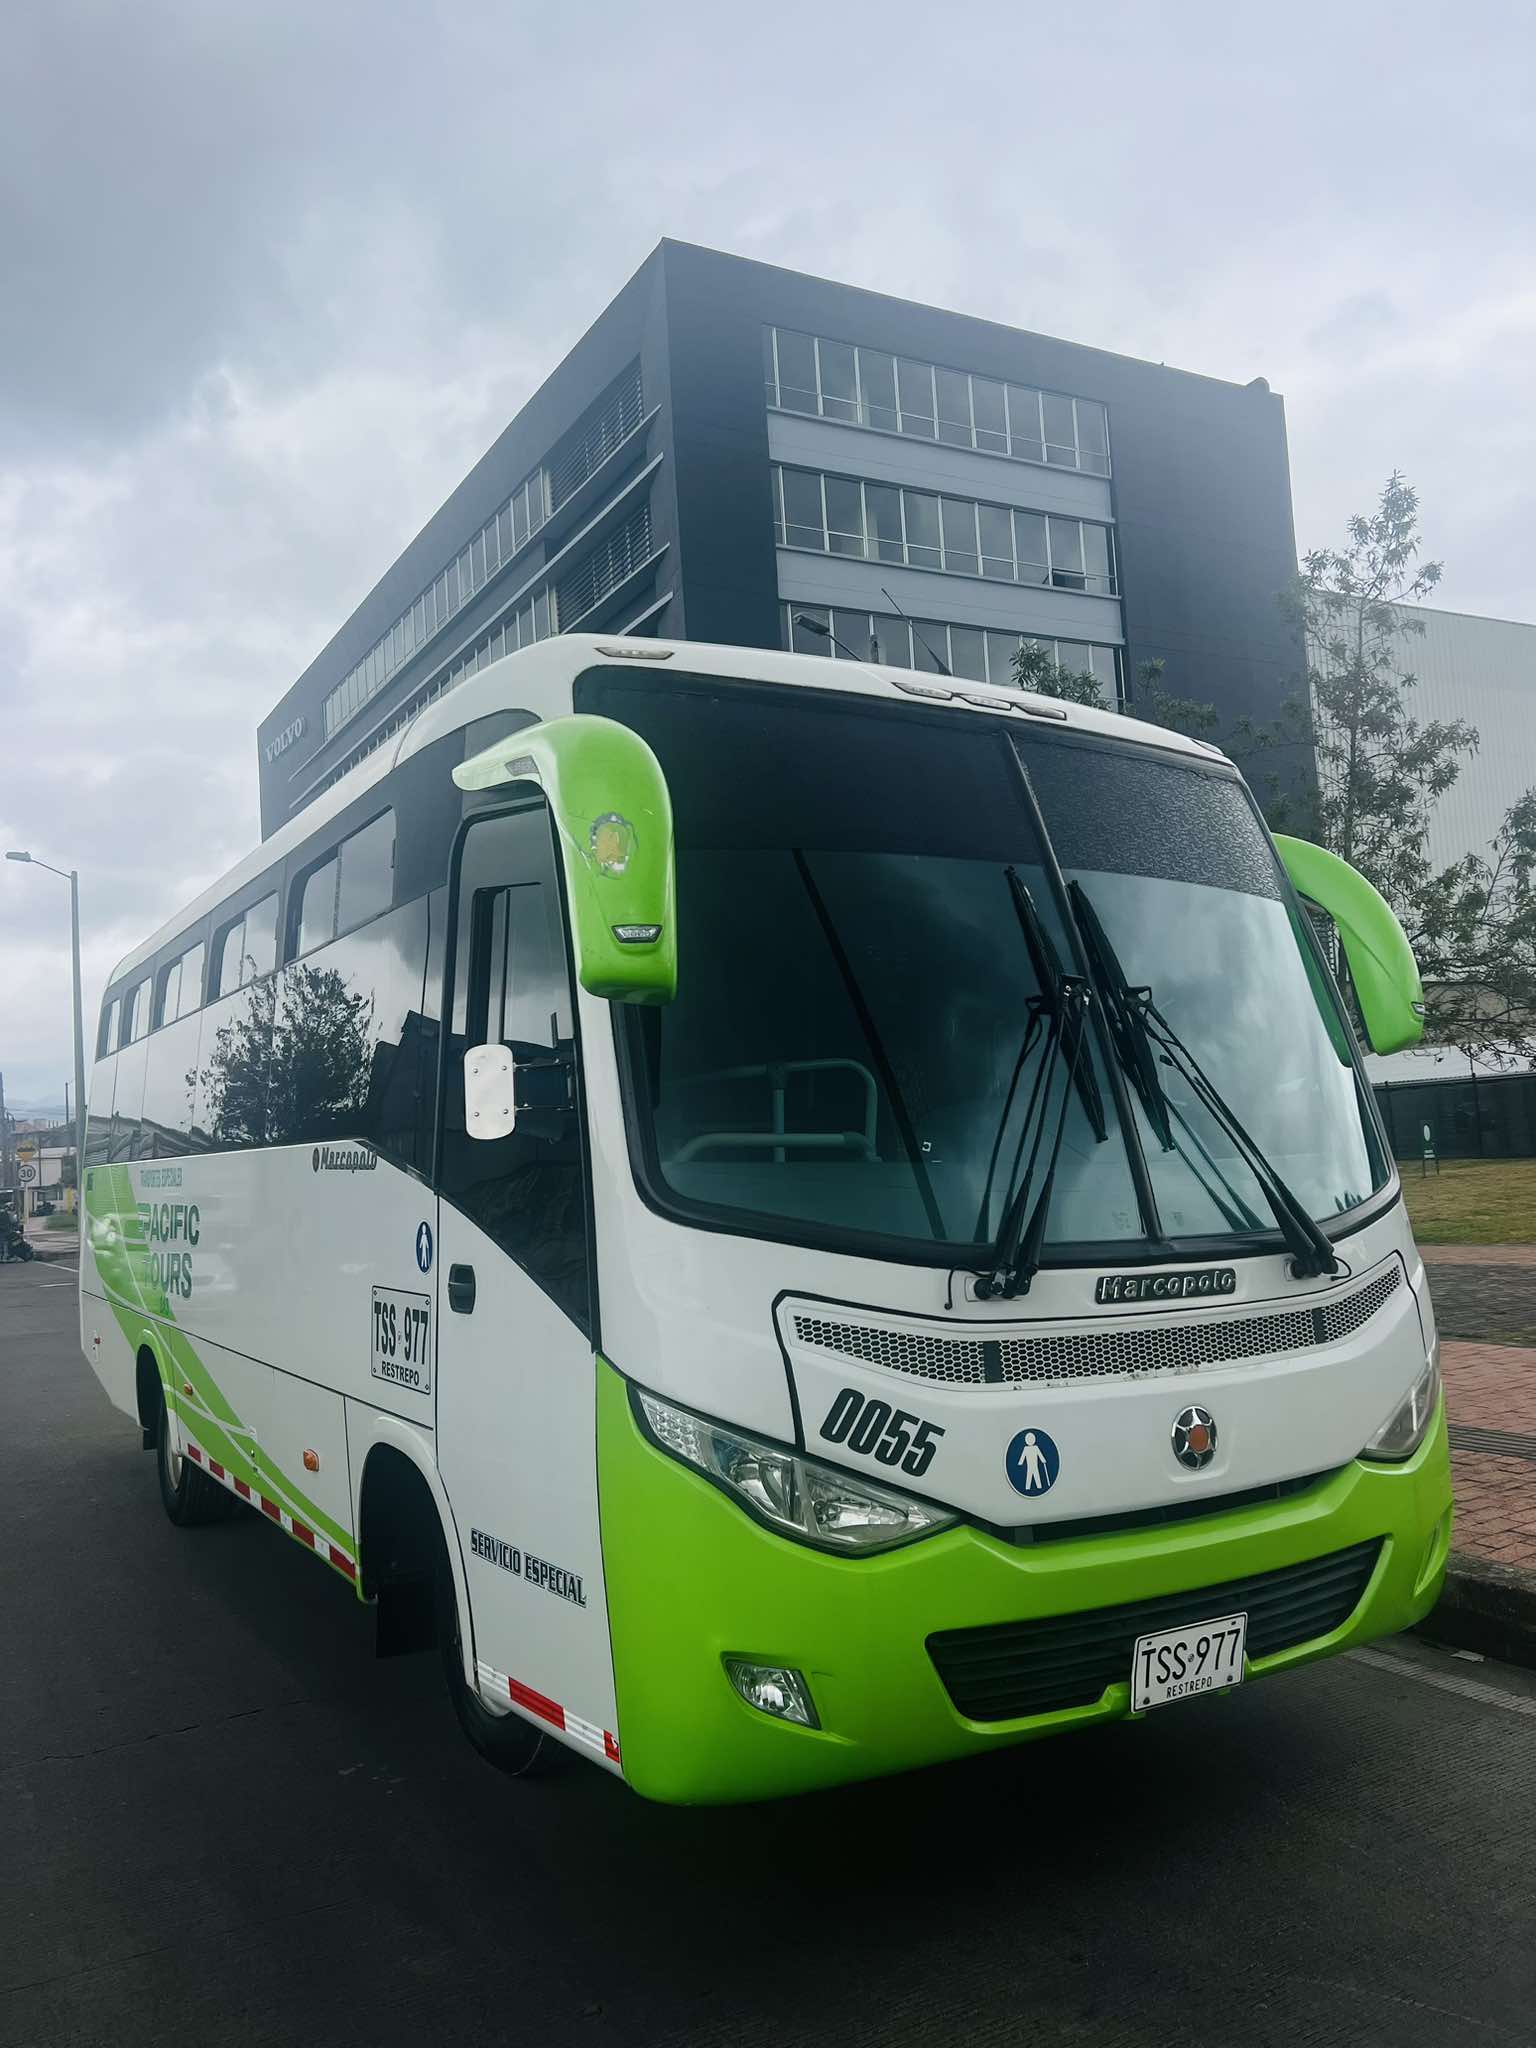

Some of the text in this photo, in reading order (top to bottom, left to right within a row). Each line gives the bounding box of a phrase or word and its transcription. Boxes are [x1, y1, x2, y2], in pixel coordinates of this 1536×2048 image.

[266, 717, 302, 763] VOLVO
[20, 1169, 33, 1178] 30
[1101, 1270, 1233, 1300] Marcopolo
[373, 1301, 429, 1365] TSS 977
[381, 1360, 420, 1386] RESTREPO
[819, 1387, 946, 1478] 0055
[471, 1527, 587, 1609] SERVICIO ESPECIAL
[1166, 1676, 1213, 1699] RESTREPO
